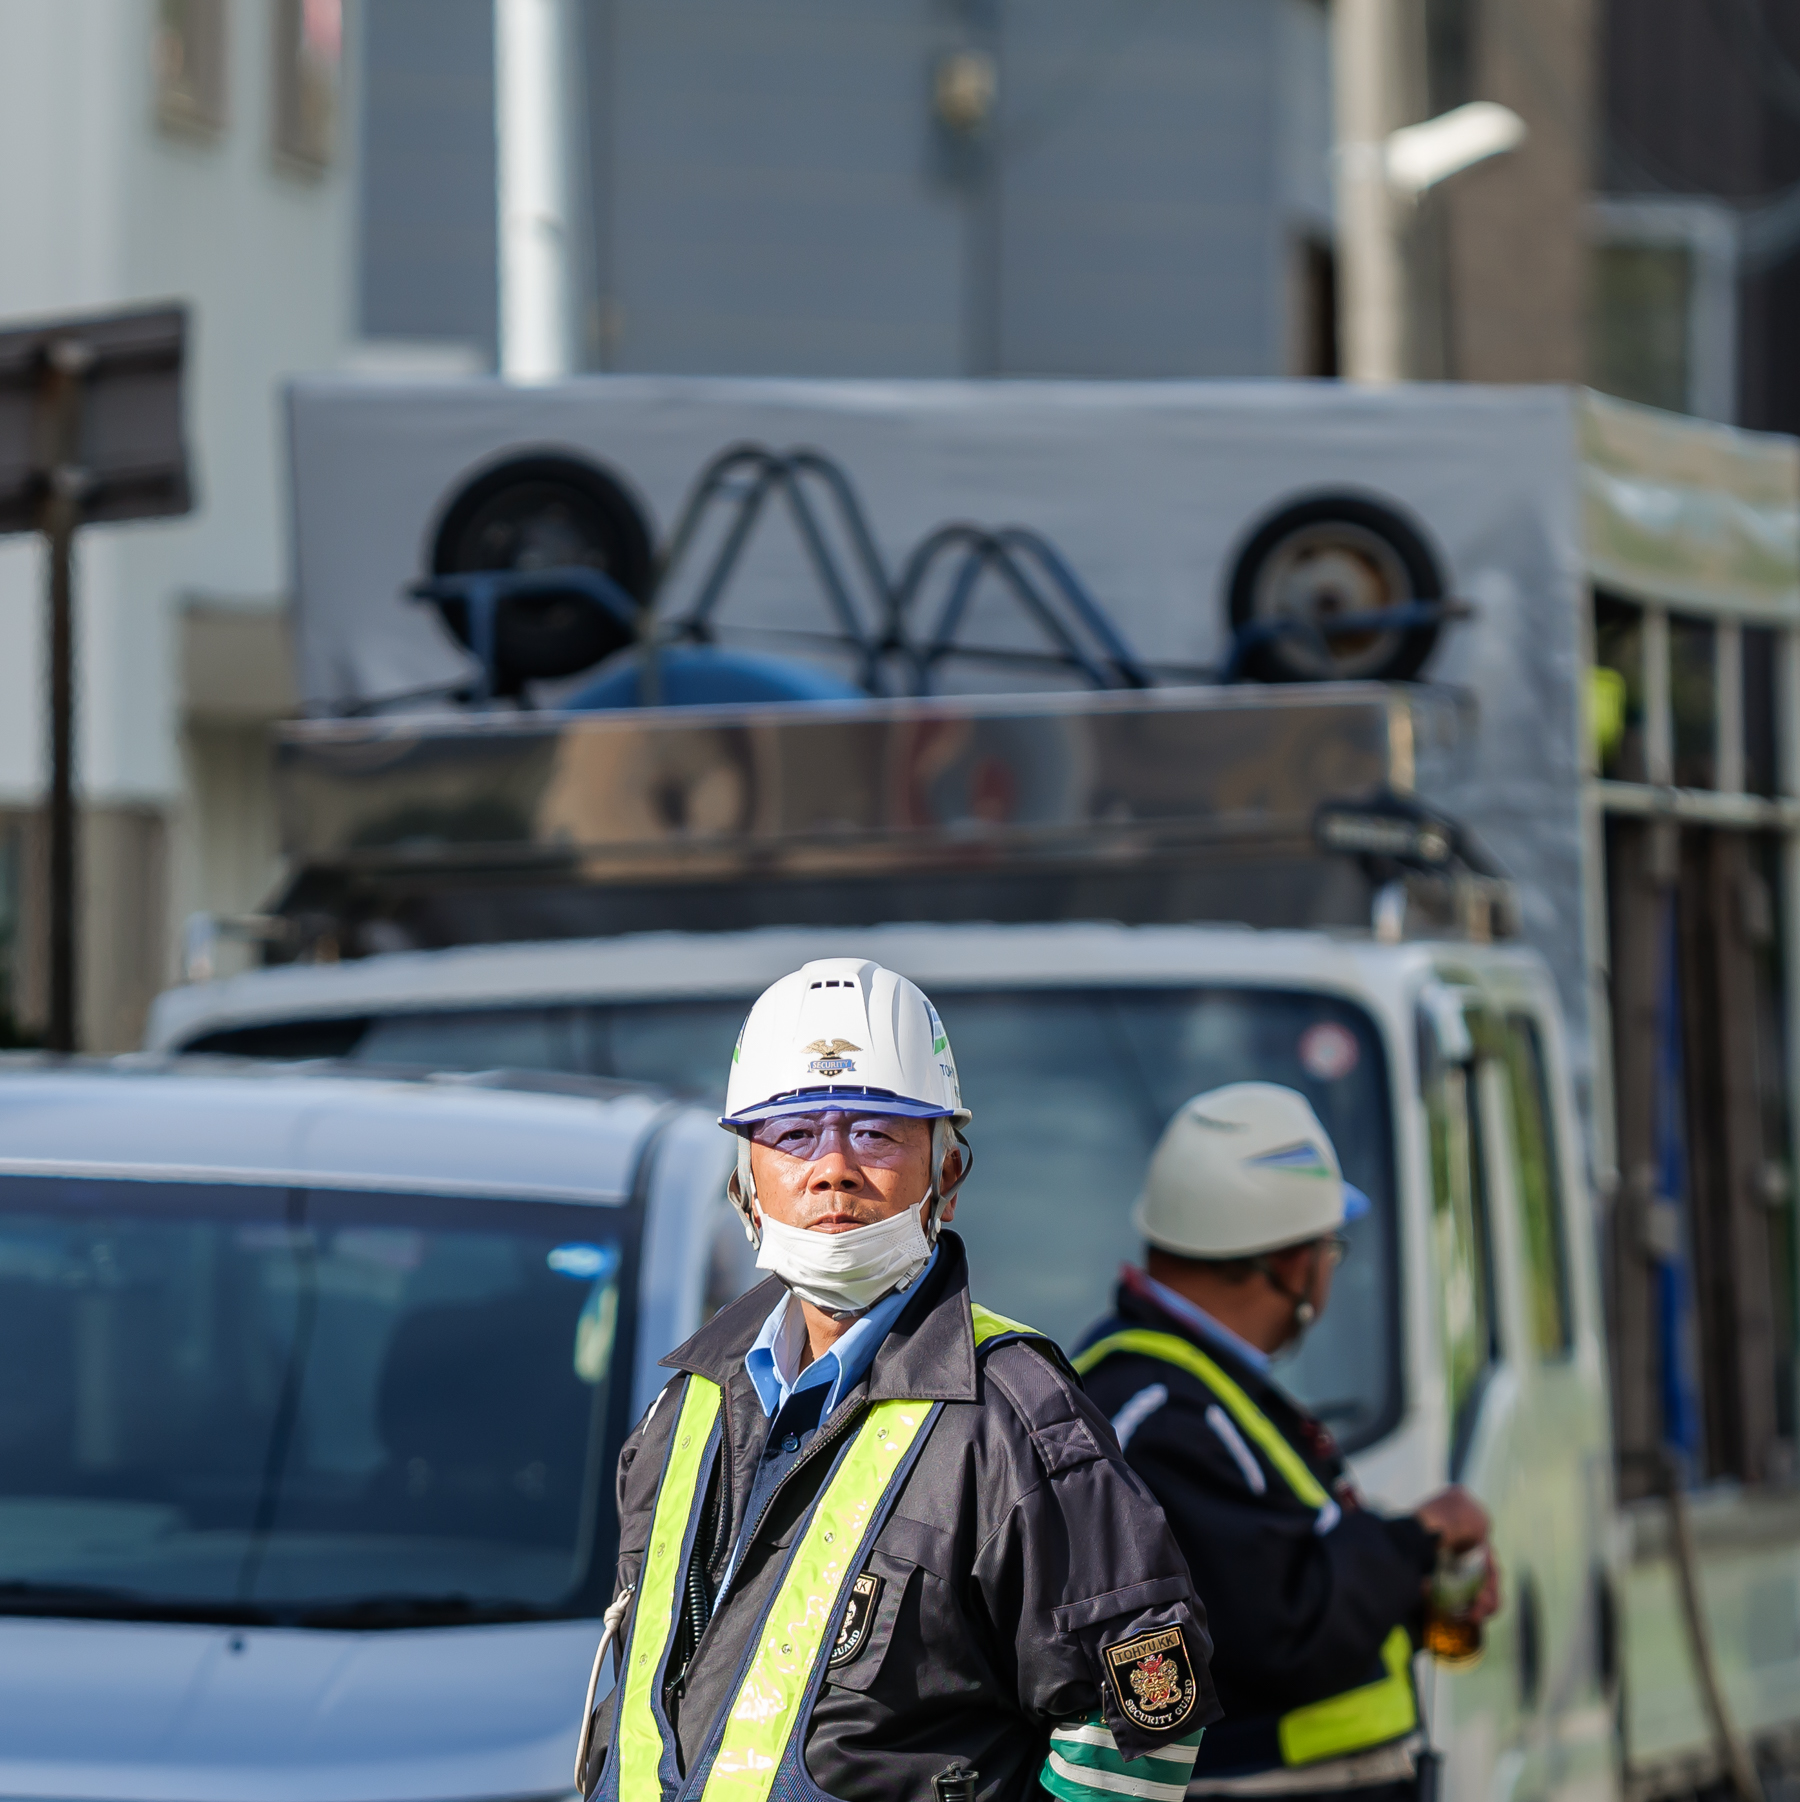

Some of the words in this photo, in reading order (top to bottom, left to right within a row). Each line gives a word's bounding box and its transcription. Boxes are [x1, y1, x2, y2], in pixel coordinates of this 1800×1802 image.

[811, 1060, 849, 1069] SECURITY
[1125, 1698, 1173, 1725] SECURITY
[1175, 1679, 1192, 1715] GUARD
